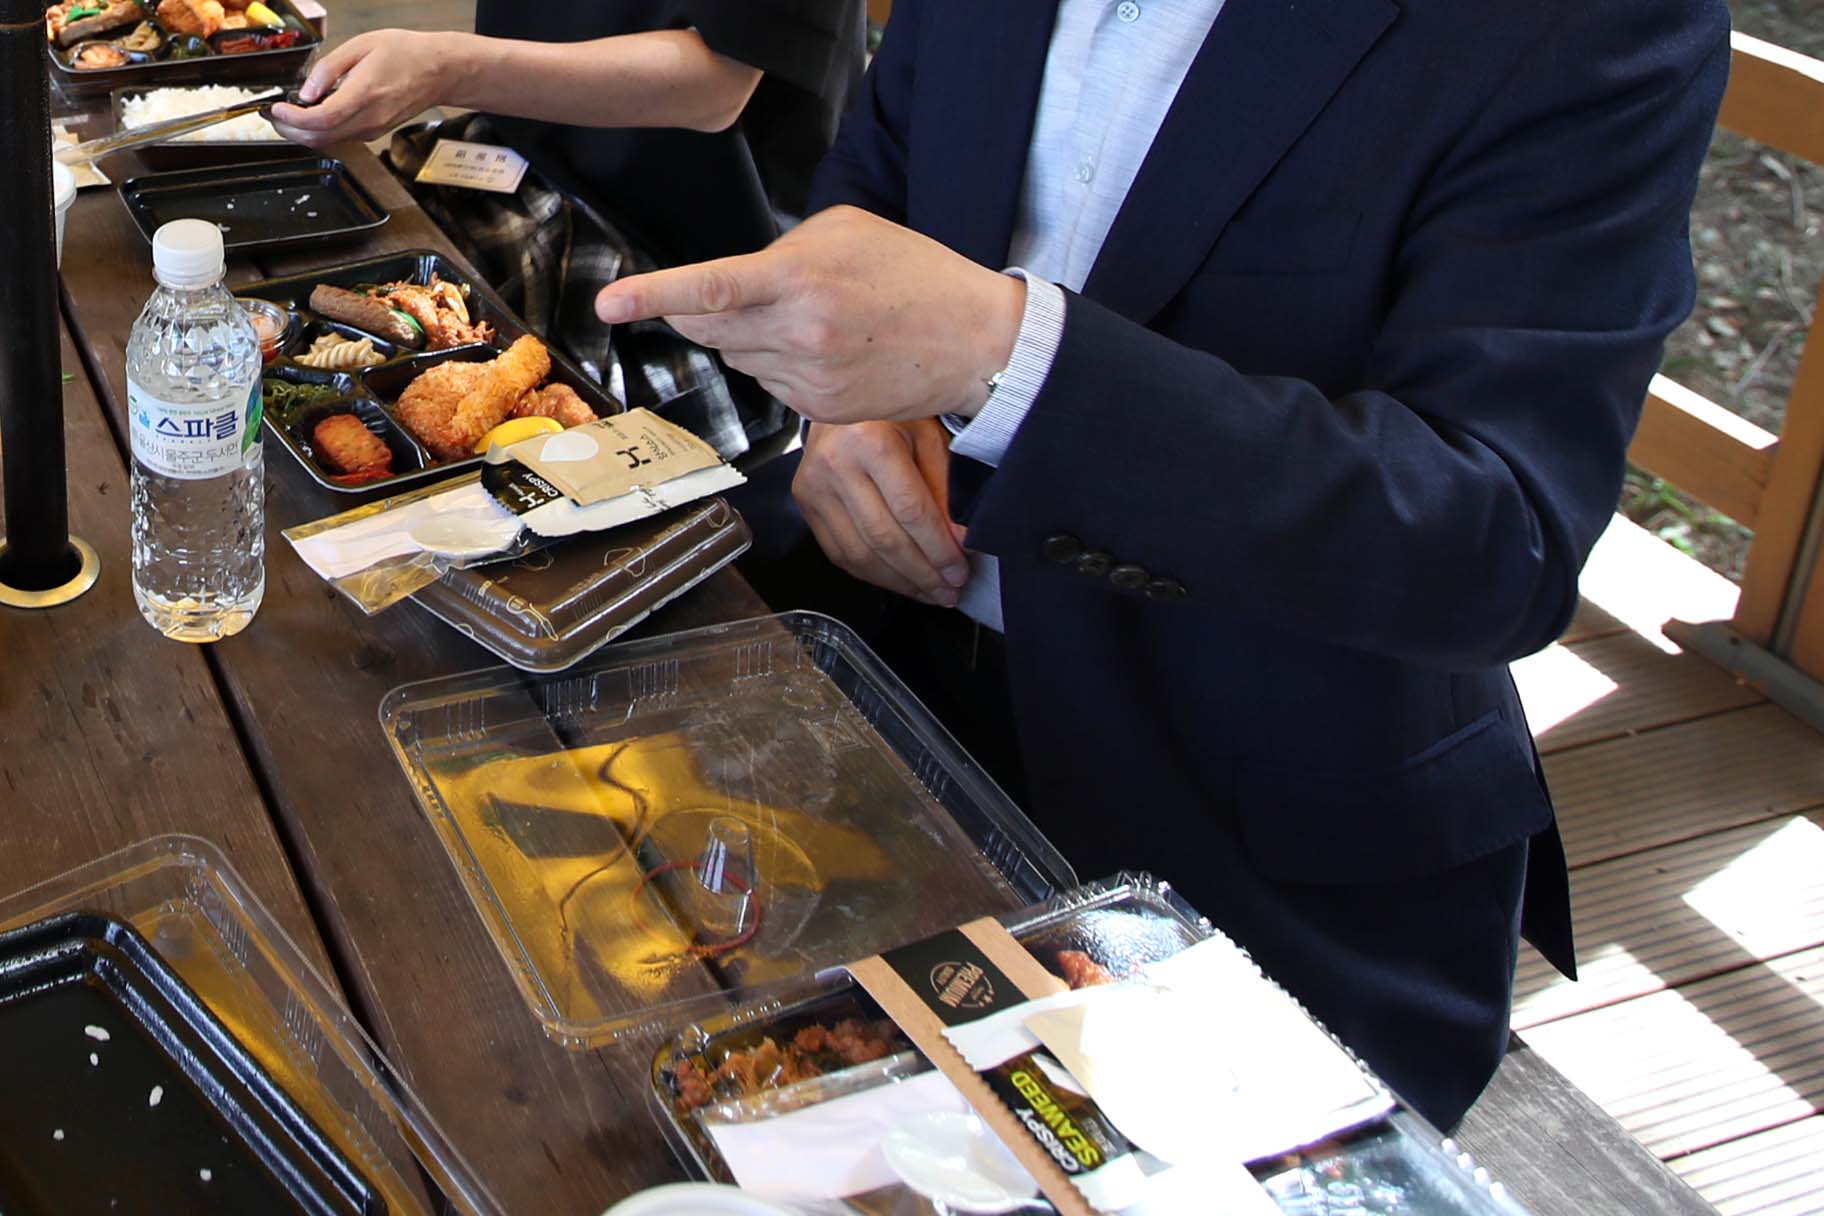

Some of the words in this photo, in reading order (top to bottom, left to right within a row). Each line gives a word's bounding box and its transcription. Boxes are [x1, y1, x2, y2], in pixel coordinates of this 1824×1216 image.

[155, 409, 239, 441] 스파클
[521, 472, 560, 498] CRISPY
[1010, 1070, 1100, 1167] SEAWEED
[1015, 1107, 1079, 1173] CRISPY
